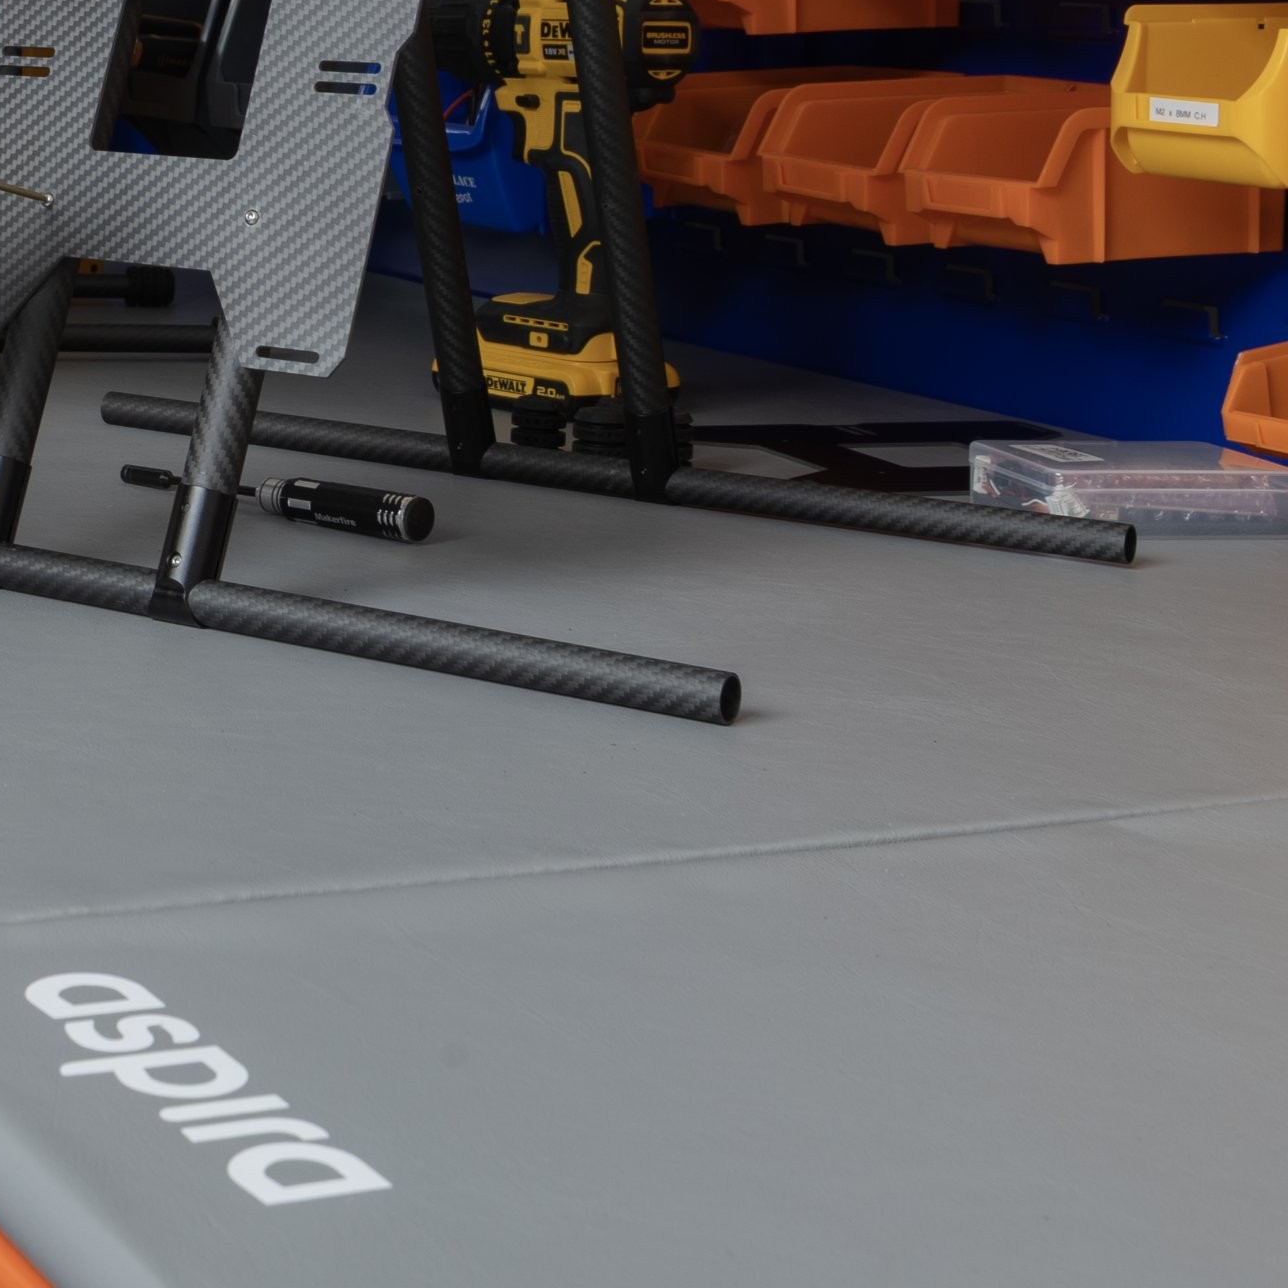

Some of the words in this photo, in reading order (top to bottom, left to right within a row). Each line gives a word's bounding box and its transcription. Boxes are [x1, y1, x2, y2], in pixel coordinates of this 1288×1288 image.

[646, 31, 687, 40] BRUSHLESS
[1155, 107, 1166, 116] M2
[314, 512, 357, 527] Makerfire
[25, 972, 393, 1207] aspira
